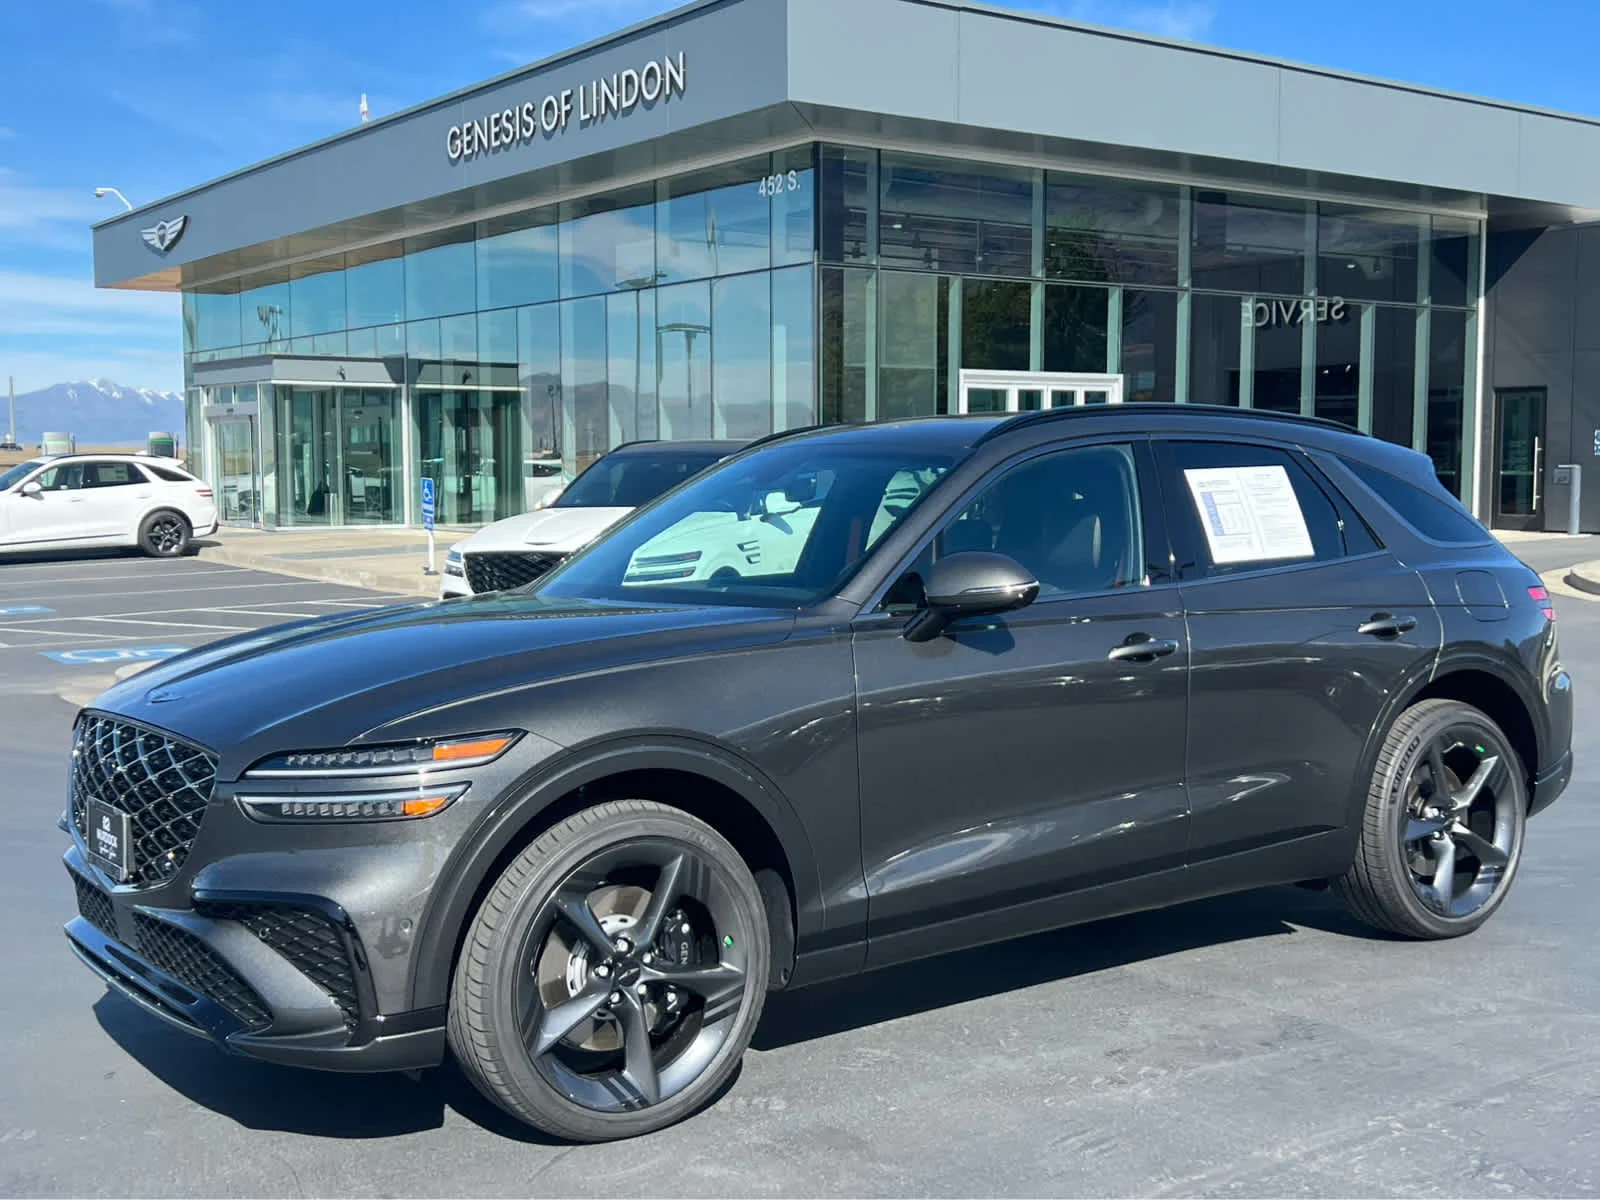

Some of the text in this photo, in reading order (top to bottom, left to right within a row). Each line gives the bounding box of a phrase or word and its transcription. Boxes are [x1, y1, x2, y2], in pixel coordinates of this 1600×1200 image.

[446, 50, 684, 159] GENESIS OF LINDON
[758, 169, 801, 198] 452 S.
